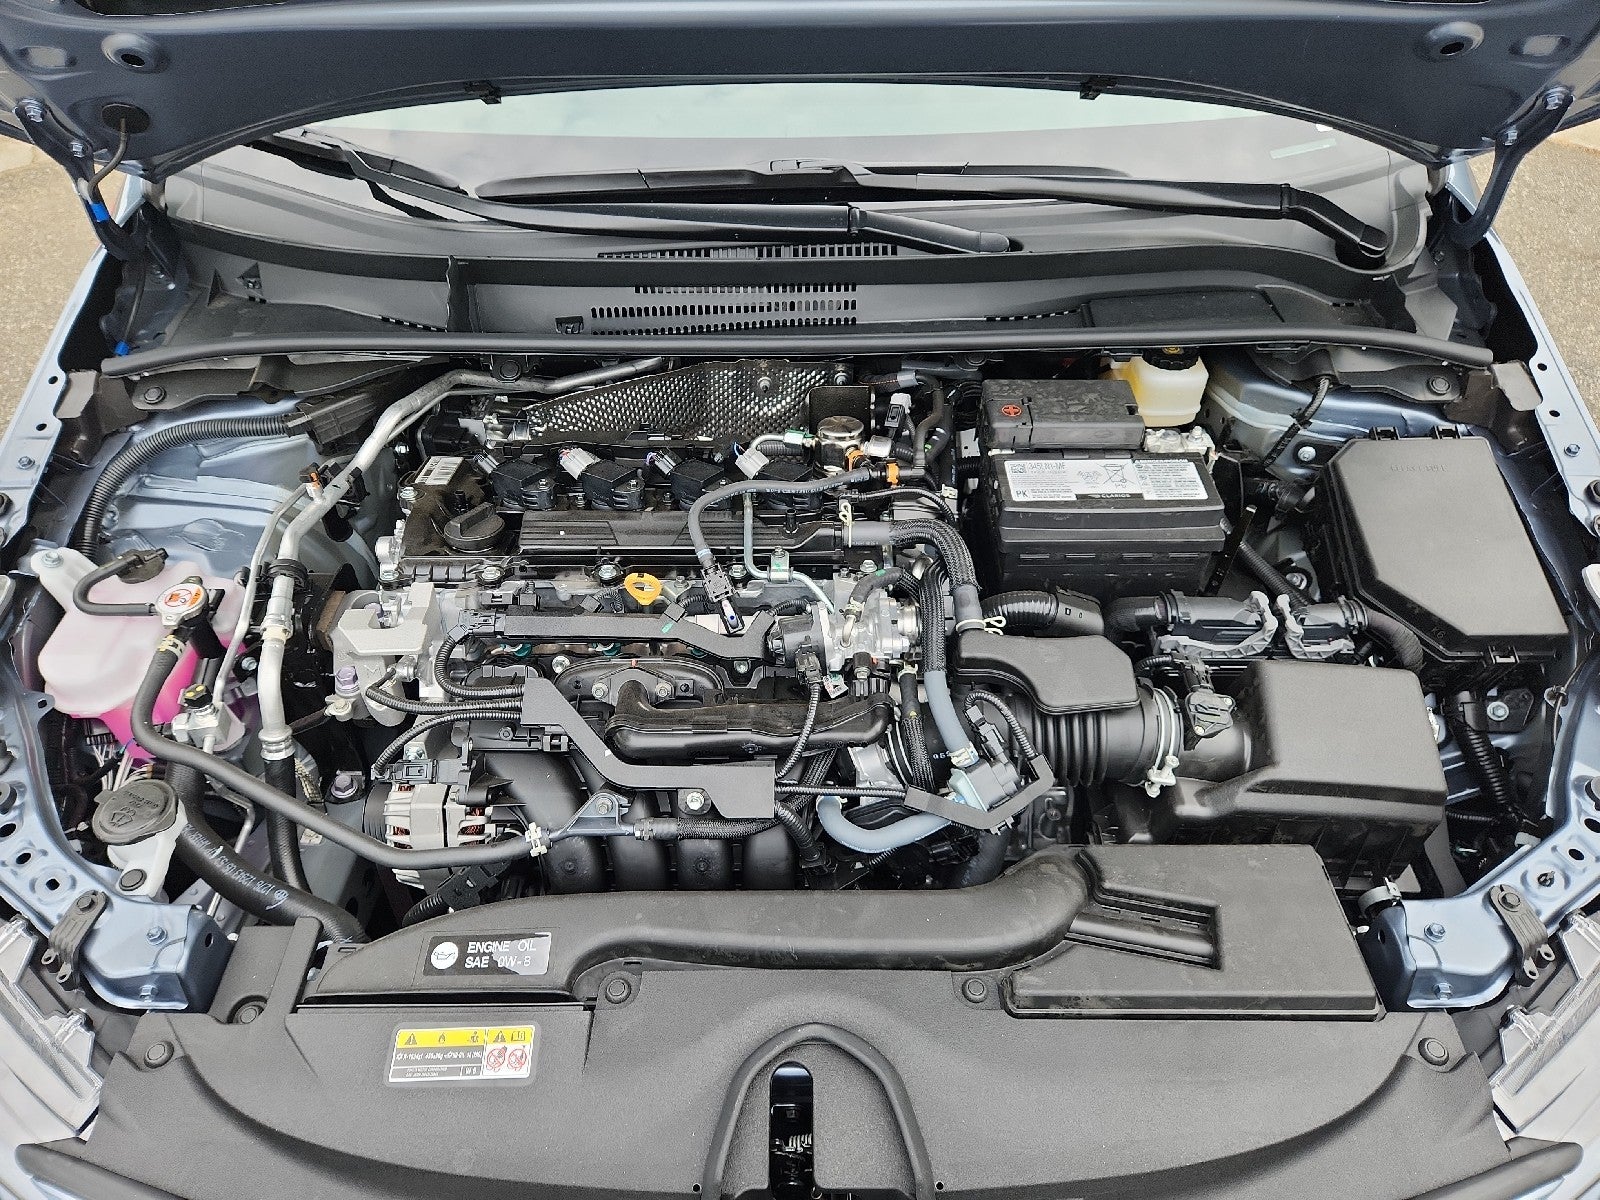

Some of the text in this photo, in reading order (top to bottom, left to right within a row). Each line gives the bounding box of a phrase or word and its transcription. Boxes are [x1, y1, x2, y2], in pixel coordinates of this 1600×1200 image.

[1015, 490, 1029, 498] PK
[467, 940, 536, 953] ENGINE OIL
[465, 956, 490, 968] SAE
